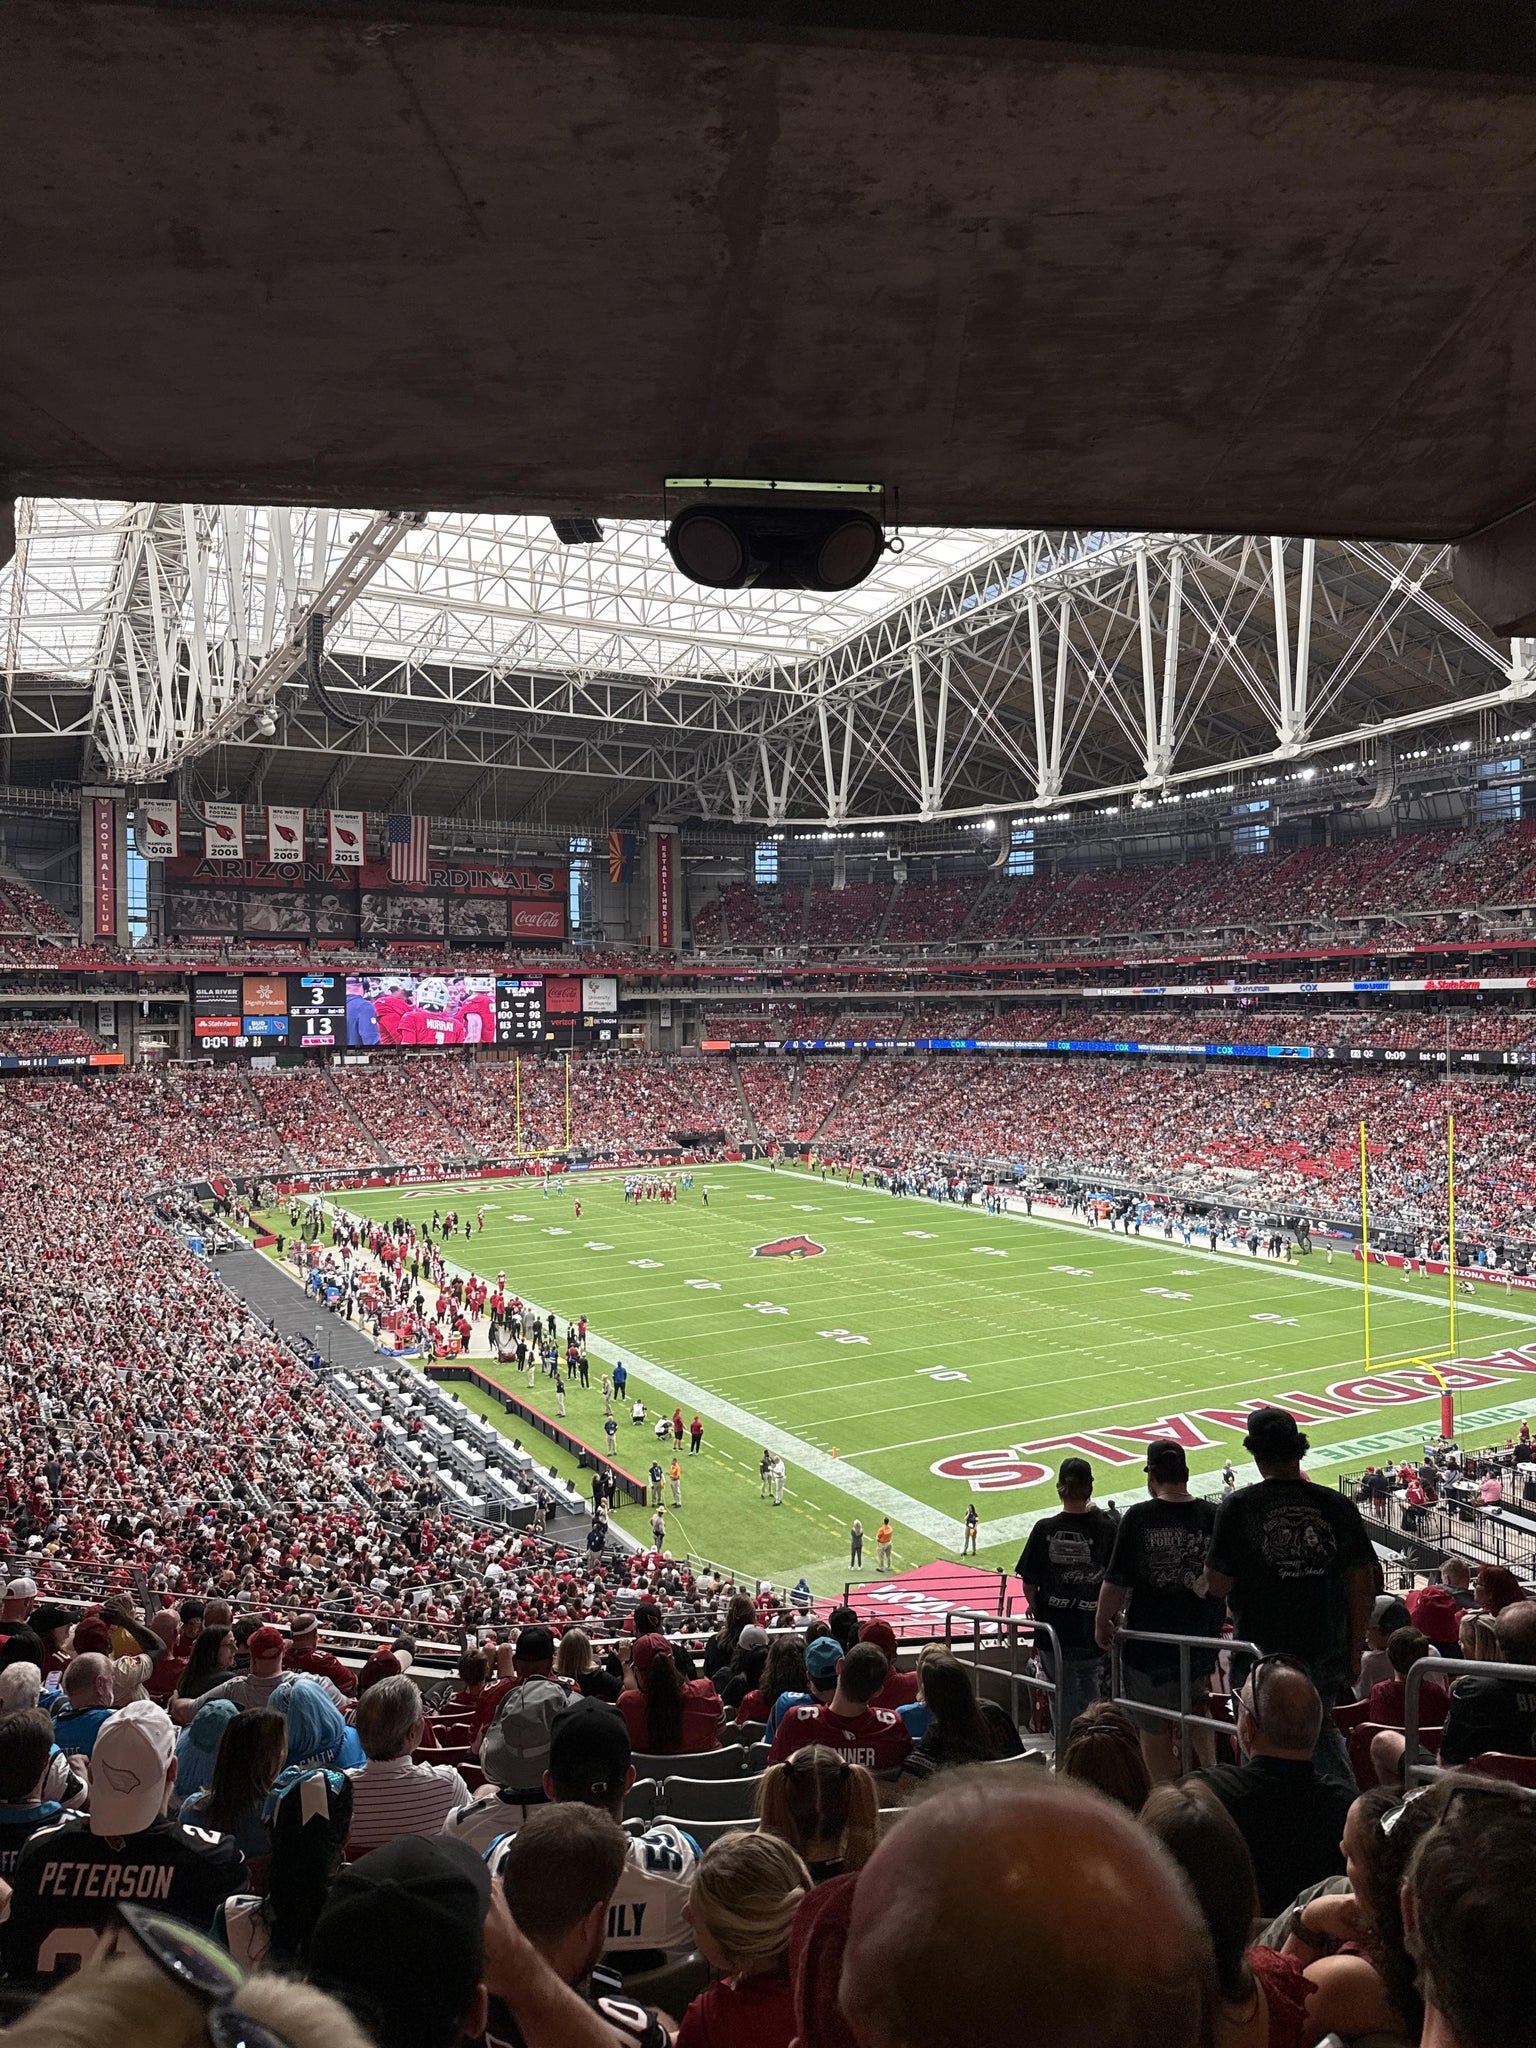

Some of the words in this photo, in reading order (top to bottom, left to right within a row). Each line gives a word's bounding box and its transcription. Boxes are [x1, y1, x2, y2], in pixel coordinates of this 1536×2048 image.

[101, 812, 109, 891] FOOTBALL
[147, 846, 173, 854] 008
[273, 852, 299, 860] 2009
[335, 854, 360, 862] 2015
[193, 859, 350, 882] ARIZONA
[101, 893, 109, 932] CLUB
[311, 988, 325, 1005] 3
[529, 1001, 541, 1009] 36
[497, 1011, 513, 1020] 100
[529, 1011, 541, 1020] 98
[306, 1017, 332, 1035] 13
[426, 1018, 454, 1032] MURRAY
[501, 1030, 509, 1039] 6
[531, 1030, 538, 1039] 7
[202, 1036, 229, 1049] 0:09
[950, 1040, 966, 1048] COX
[1057, 1042, 1071, 1050] COX
[1115, 1043, 1129, 1051] COX
[1216, 1046, 1234, 1055] COX
[1327, 1048, 1335, 1058] 3
[1363, 1050, 1374, 1058] Q2
[1385, 1051, 1406, 1060] 0:09
[1419, 1052, 1431, 1061] 1st
[1436, 1052, 1447, 1061] 10
[1502, 1052, 1519, 1064] 13
[402, 1175, 437, 1183] ARIZONA
[627, 1258, 665, 1269] 50
[1443, 1267, 1486, 1280] AIZONA
[683, 1278, 722, 1290] 40
[743, 1301, 789, 1315] 30
[815, 1328, 871, 1345] 20
[914, 1364, 970, 1383] 10
[929, 1343, 1536, 1493] ARDINALS
[1315, 1434, 1410, 1460] LOVE
[182, 1824, 222, 1845] 2
[38, 1861, 175, 1900] PETERSON
